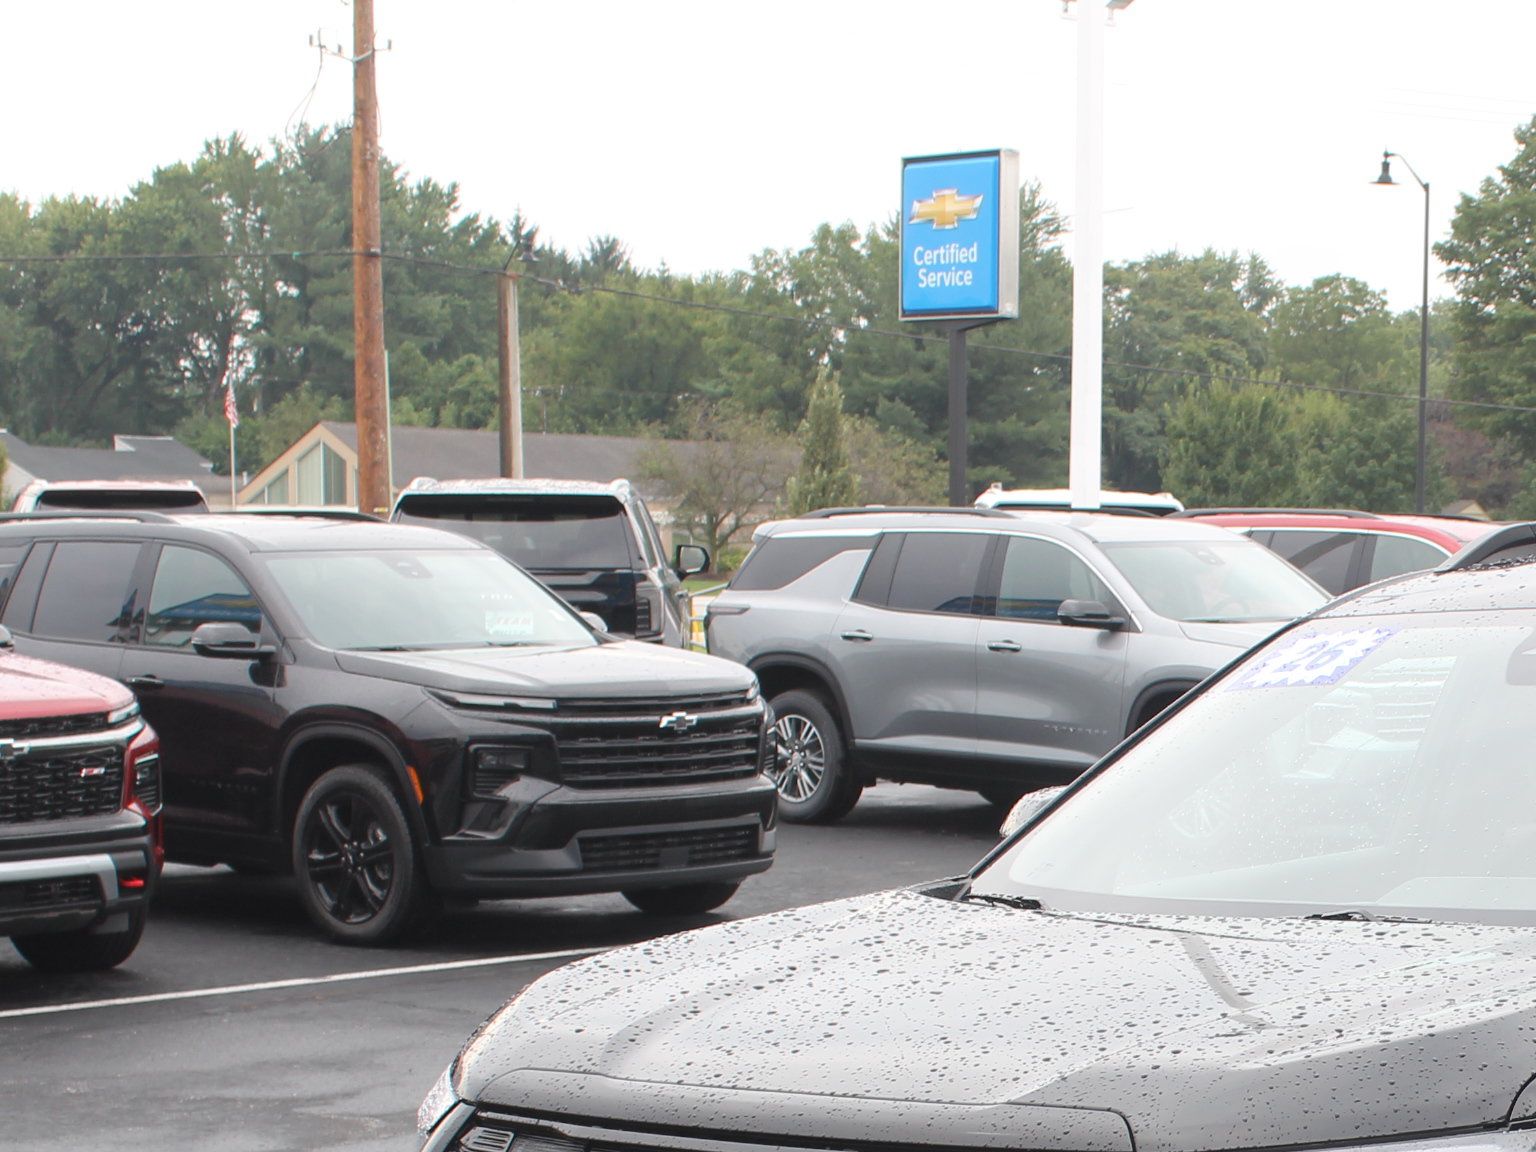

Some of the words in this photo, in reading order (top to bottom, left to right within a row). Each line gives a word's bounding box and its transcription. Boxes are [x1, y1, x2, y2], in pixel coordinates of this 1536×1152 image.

[913, 241, 978, 266] Certified
[917, 266, 973, 288] Service
[1272, 638, 1359, 672] 26
